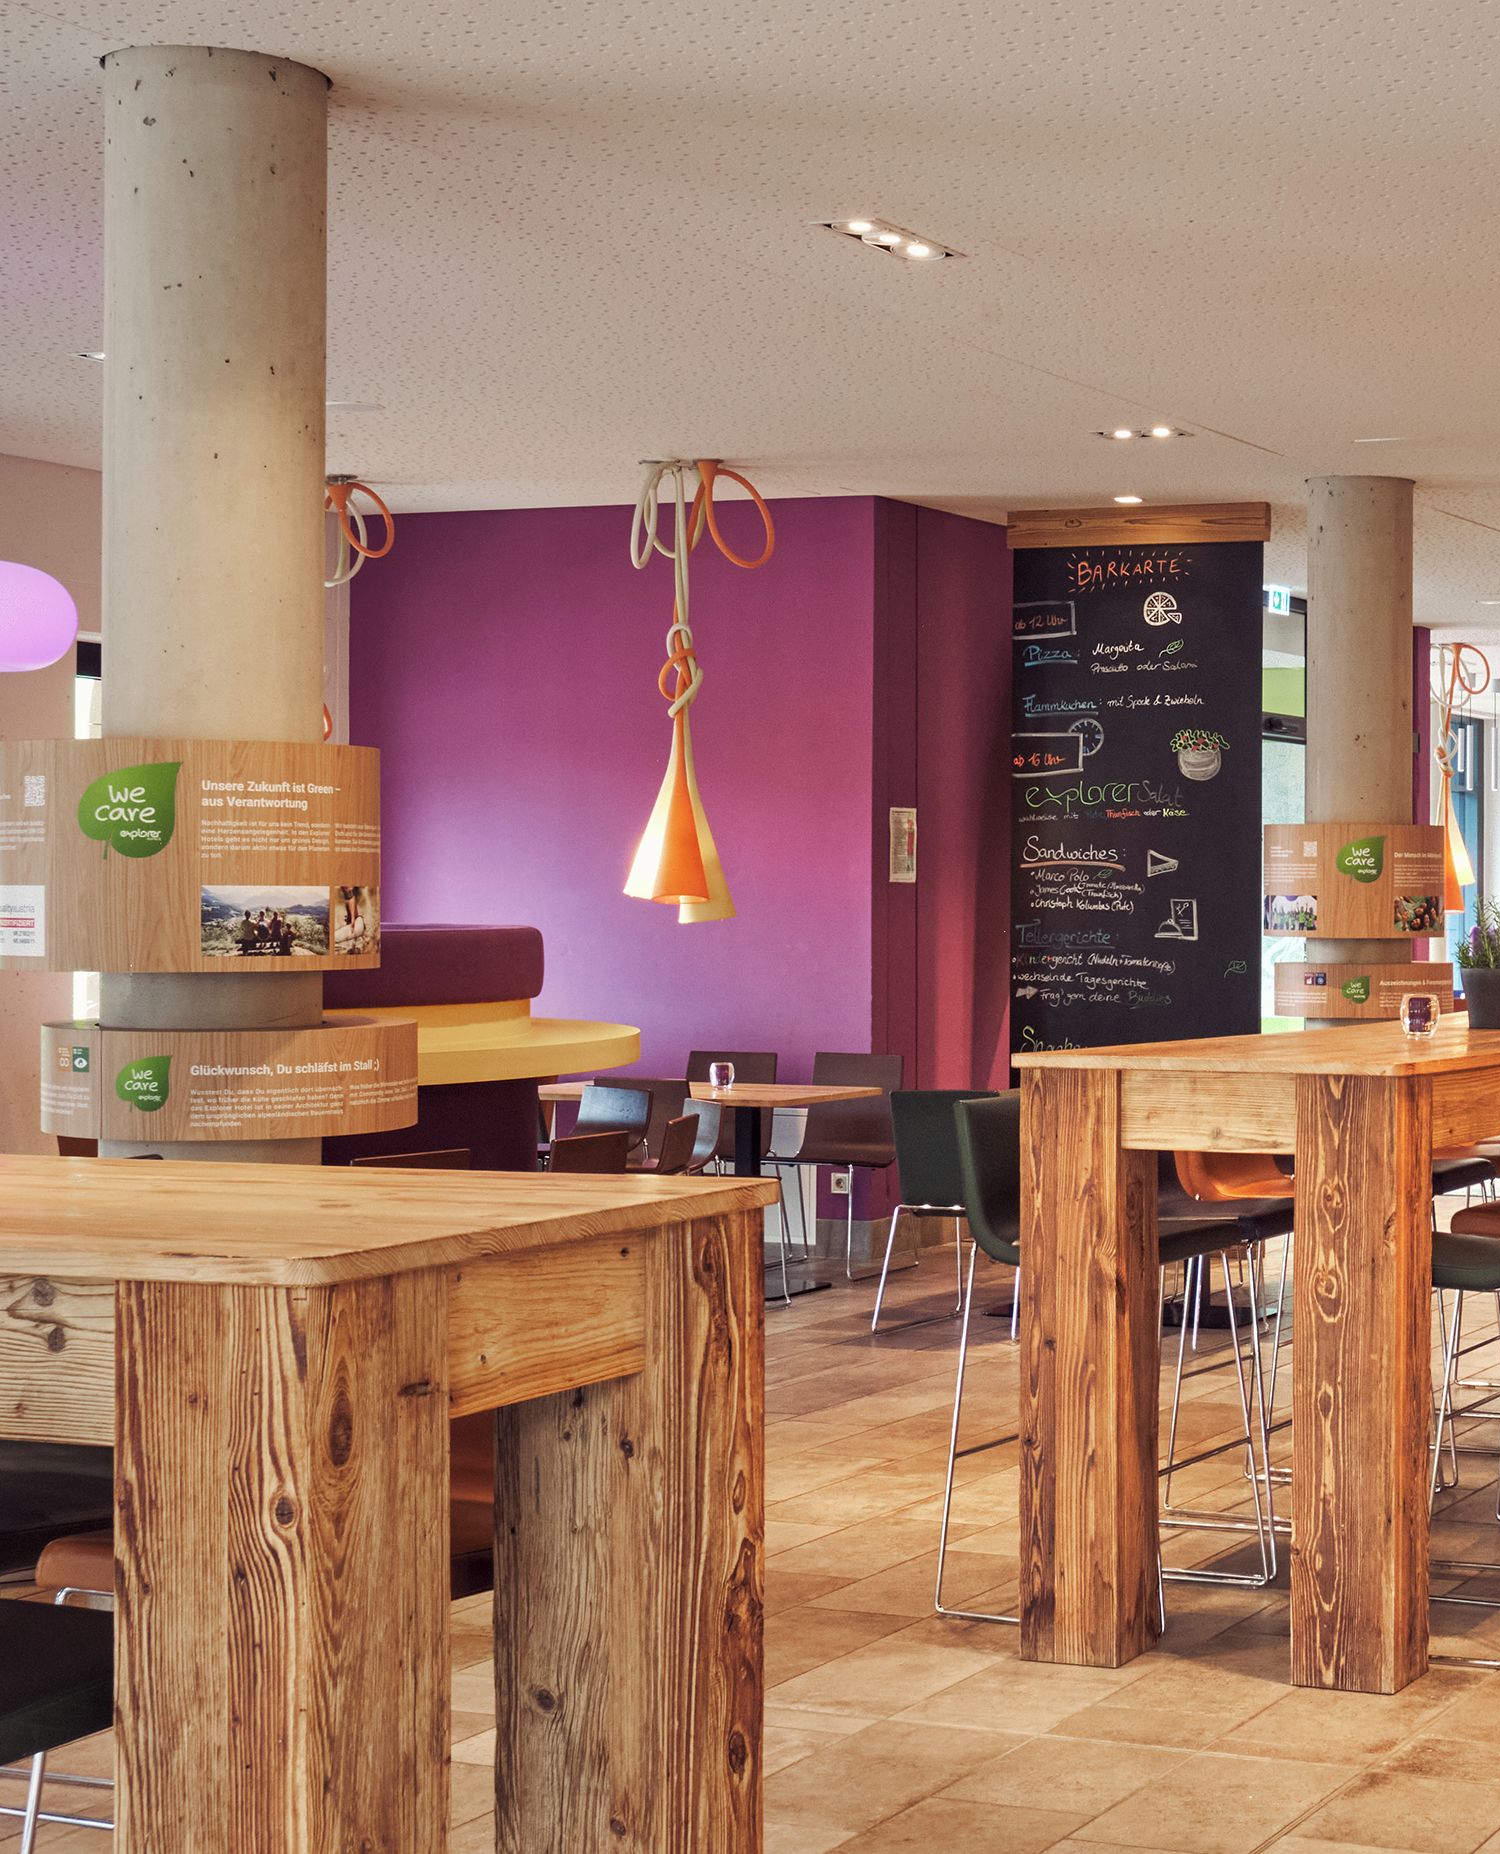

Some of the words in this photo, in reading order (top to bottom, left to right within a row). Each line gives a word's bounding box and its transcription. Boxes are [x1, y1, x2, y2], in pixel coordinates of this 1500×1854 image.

[1078, 559, 1183, 585] BARKARTE
[1136, 661, 1162, 671] oder
[1107, 695, 1125, 707] mit
[201, 780, 244, 791] Unsere
[247, 781, 291, 792] Zukunft
[293, 782, 305, 793] ist
[307, 783, 334, 794] Green
[201, 797, 224, 807] aus
[227, 797, 308, 811] Verantwortung
[95, 805, 156, 823] care
[1162, 807, 1190, 818] Käse
[120, 829, 162, 840] explorer
[1035, 869, 1065, 882] Marco
[1067, 867, 1090, 882] Polo
[190, 1065, 274, 1077] Glückwunsch,
[277, 1064, 293, 1075] Du
[295, 1063, 338, 1075] schläfst
[340, 1061, 352, 1072] im
[353, 1060, 373, 1071] Stall
[124, 1080, 158, 1092] care
